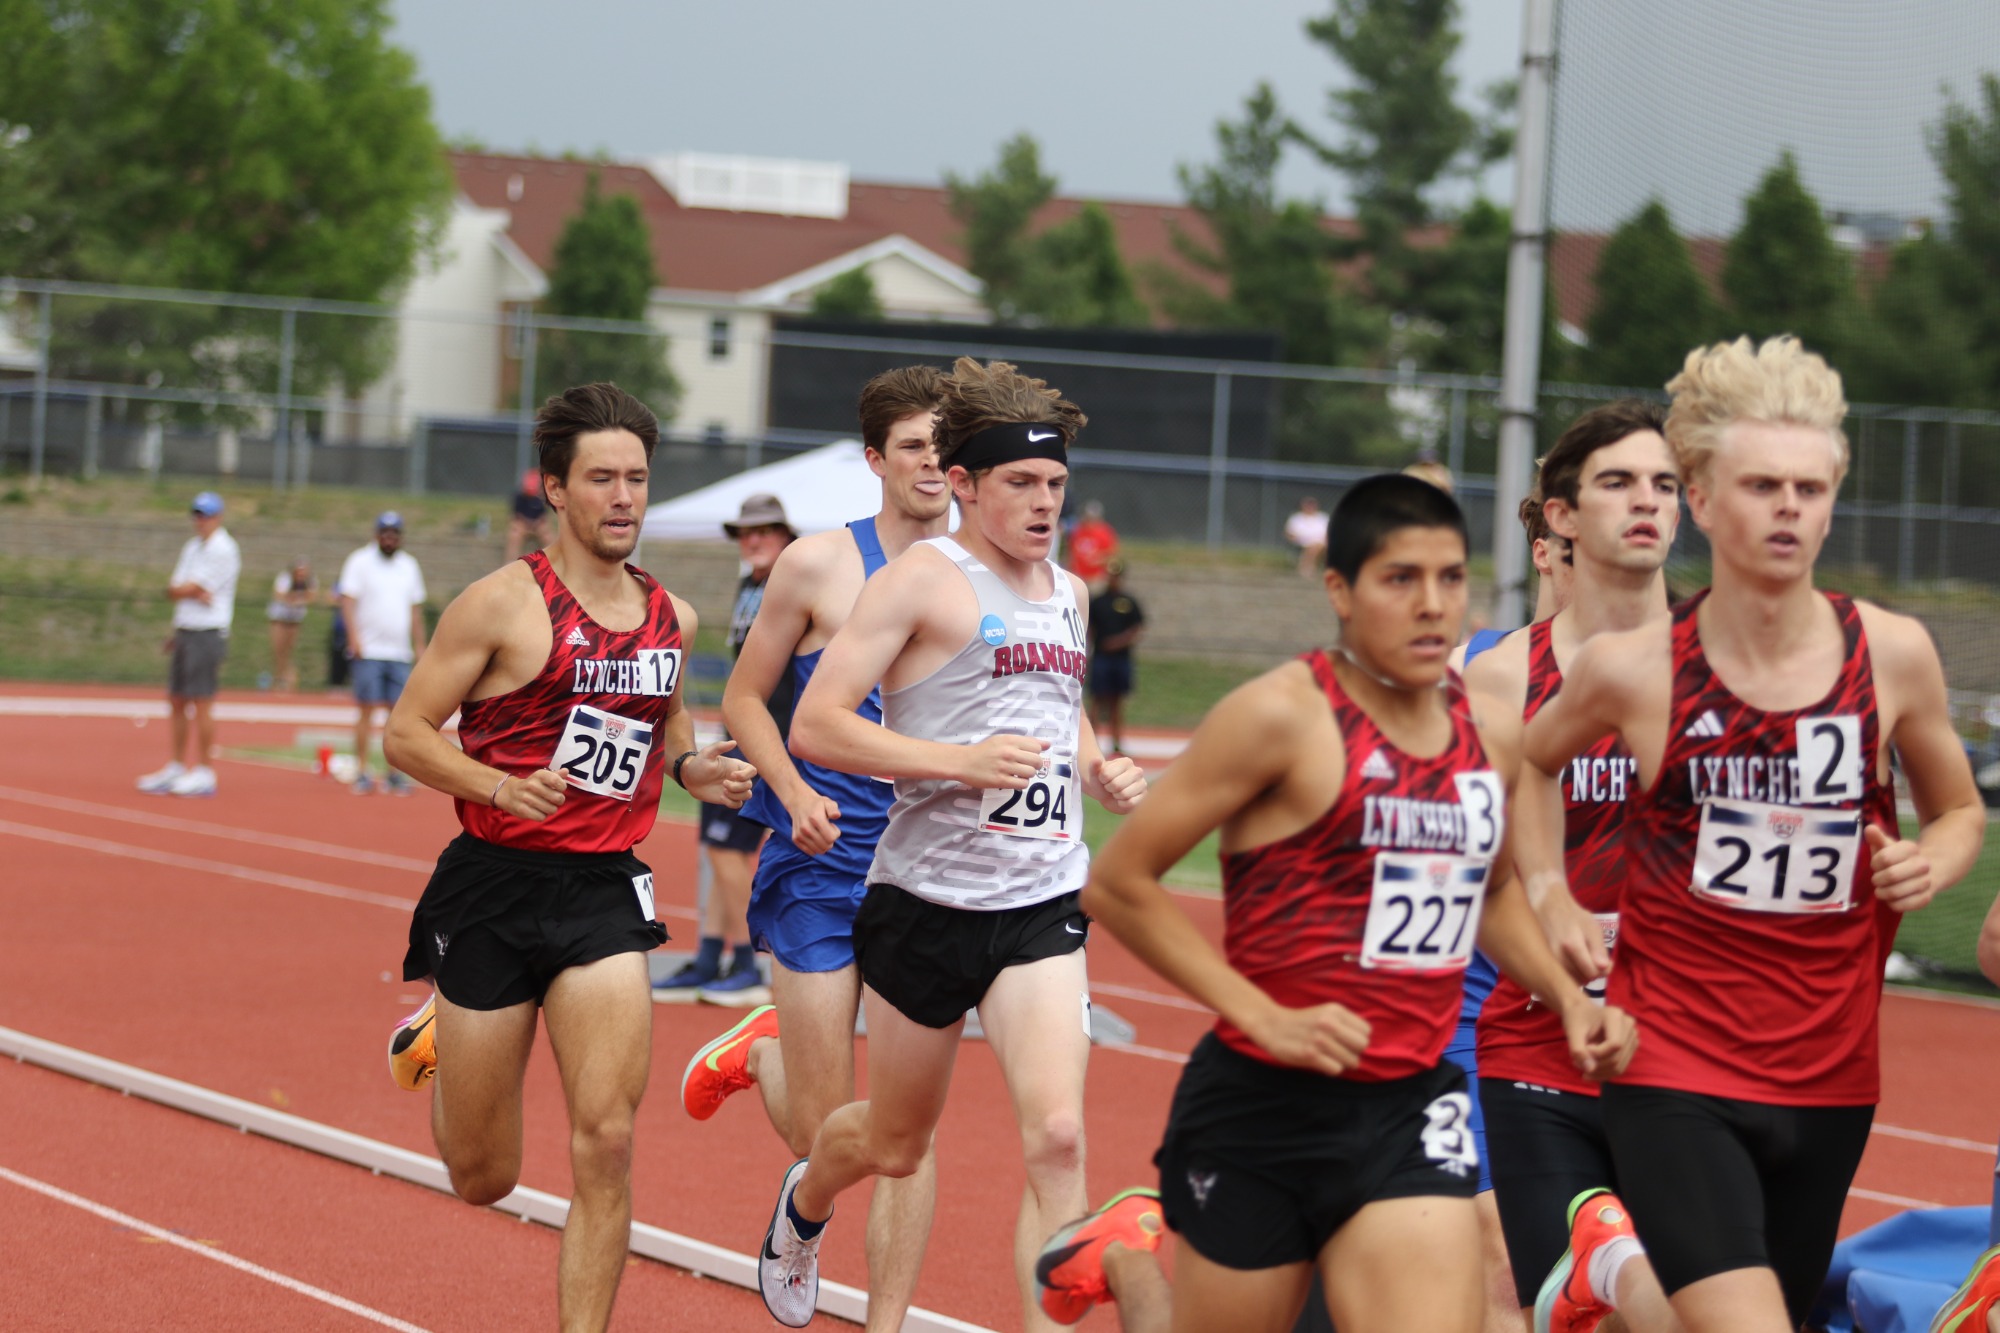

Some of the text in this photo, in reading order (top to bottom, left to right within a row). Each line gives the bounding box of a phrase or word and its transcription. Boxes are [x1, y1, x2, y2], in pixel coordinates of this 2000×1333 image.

[984, 628, 1006, 638] NCAA
[1062, 607, 1085, 649] 10
[572, 658, 642, 695] LYNCHB
[649, 652, 676, 693] 12
[563, 734, 641, 791] 205
[1811, 722, 1847, 797] 2
[988, 781, 1067, 831] 294
[1469, 779, 1496, 853] 3
[1706, 836, 1841, 902] 213
[1379, 894, 1475, 955] 227
